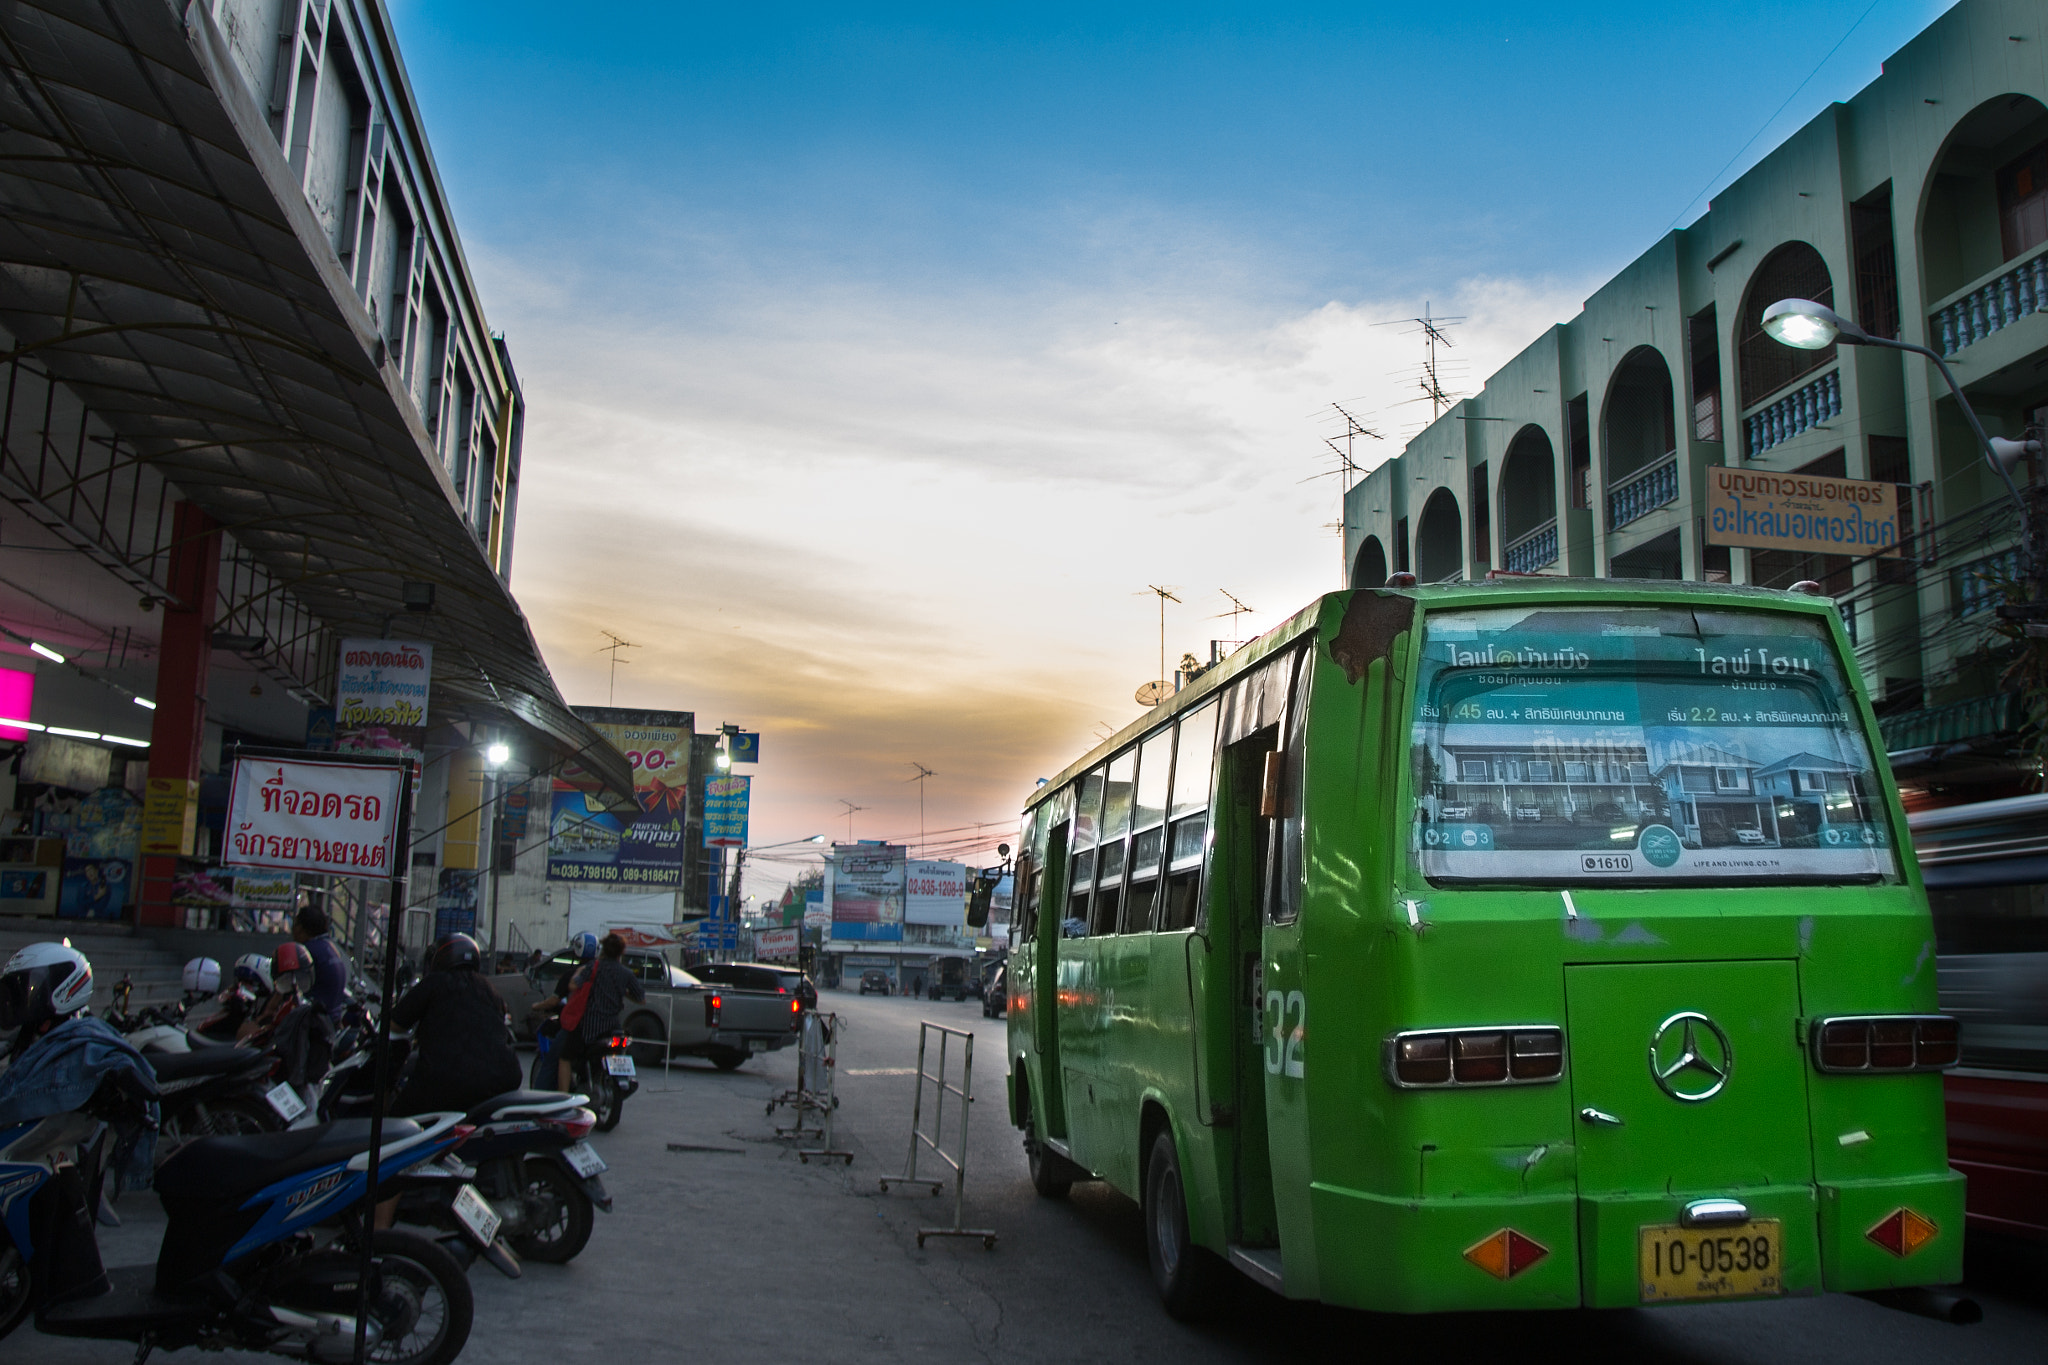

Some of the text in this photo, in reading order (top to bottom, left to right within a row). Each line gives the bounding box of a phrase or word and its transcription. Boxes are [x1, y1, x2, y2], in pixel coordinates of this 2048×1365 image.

[1420, 702, 1440, 717] เริ่ม
[1486, 708, 1508, 720] ลบ.
[1524, 707, 1625, 722] สิทธิพิเศษมากมาย
[1667, 707, 1687, 722] เริ่ม
[1691, 707, 1717, 722] 2.2
[261, 768, 382, 822] ที่จอดรถ
[234, 822, 390, 869] จักรยานยนต์
[1480, 834, 1489, 845] 3
[1596, 856, 1629, 869] 1610
[561, 864, 618, 880] 038-798150
[623, 868, 680, 884] 089-8186477
[908, 878, 964, 898] 02-935-1208-9
[1265, 990, 1306, 1079] 32
[1655, 1235, 1770, 1277] 10-0538
